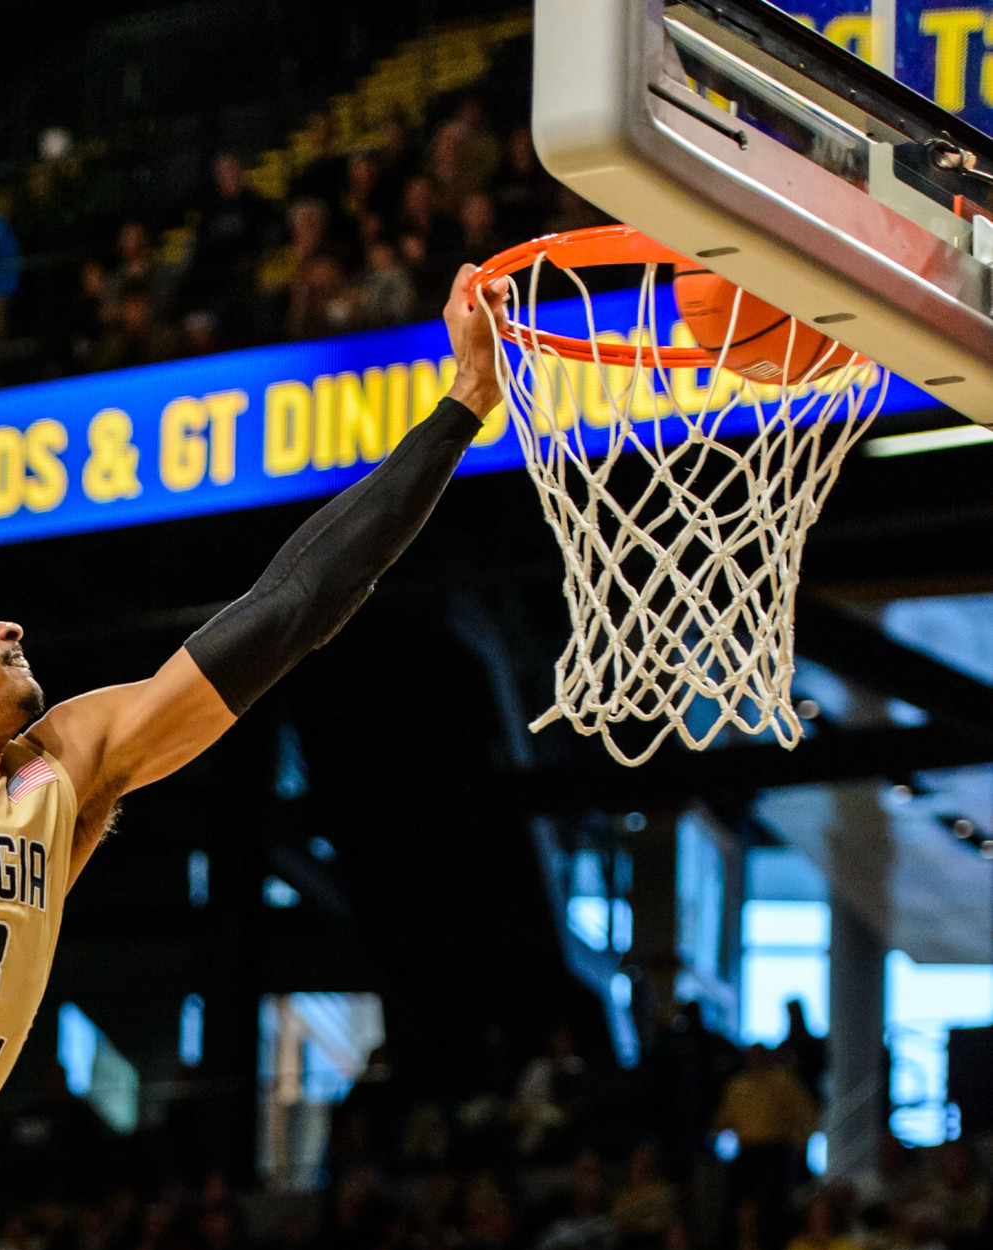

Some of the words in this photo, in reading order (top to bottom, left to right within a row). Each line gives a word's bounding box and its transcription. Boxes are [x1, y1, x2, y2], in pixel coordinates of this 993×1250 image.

[82, 406, 143, 503] &
[159, 389, 249, 492] GT
[263, 357, 508, 478] DININ
